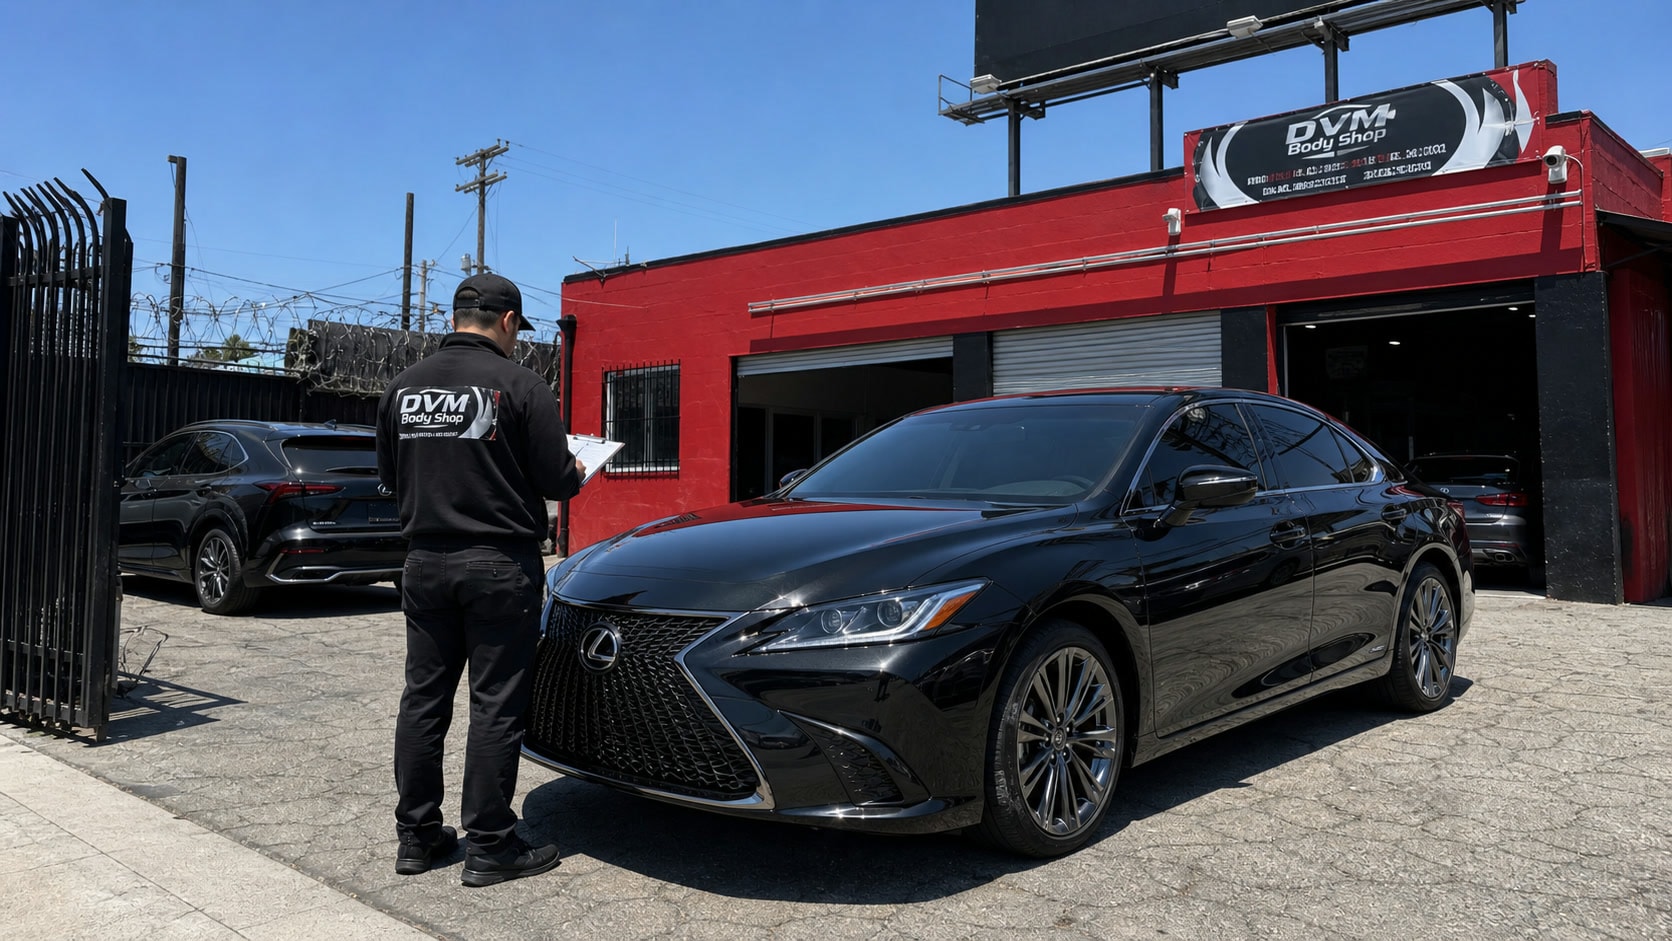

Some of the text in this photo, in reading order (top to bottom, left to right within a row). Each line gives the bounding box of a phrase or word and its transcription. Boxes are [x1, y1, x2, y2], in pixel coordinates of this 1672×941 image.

[1285, 103, 1393, 145] DVM
[1287, 128, 1387, 156] Body Shop
[400, 394, 470, 414] DVM
[401, 413, 464, 425] Body Shop
